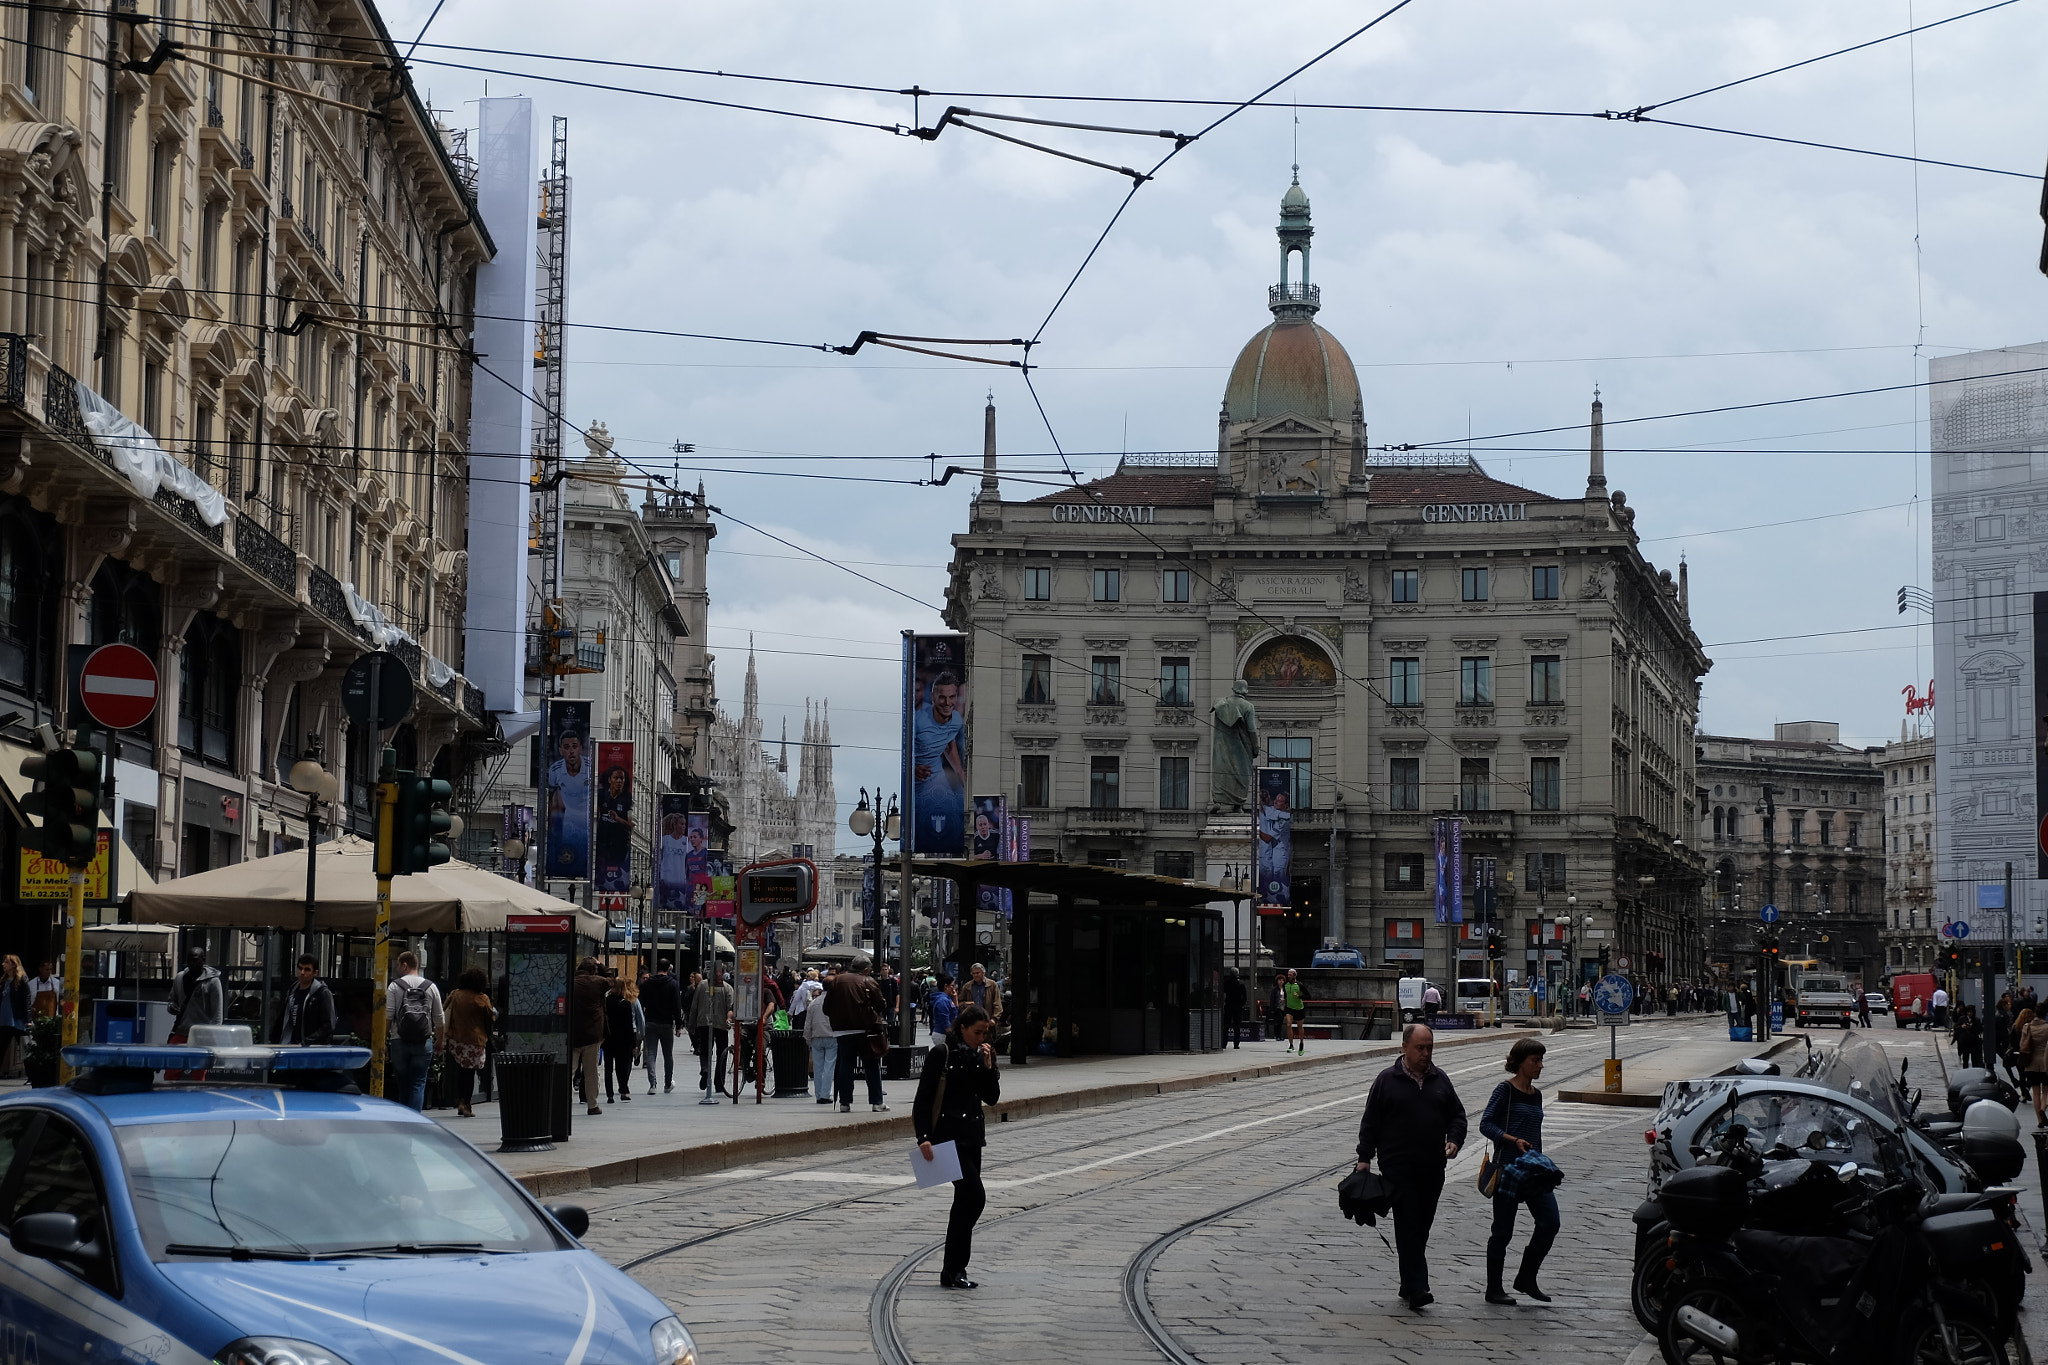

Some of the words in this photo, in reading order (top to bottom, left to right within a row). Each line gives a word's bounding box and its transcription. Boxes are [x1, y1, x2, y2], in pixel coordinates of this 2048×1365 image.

[1052, 504, 1156, 523] GENERALI
[1422, 502, 1526, 523] GENERALI
[1267, 586, 1312, 595] GENERALI
[1453, 844, 1459, 853] TO
